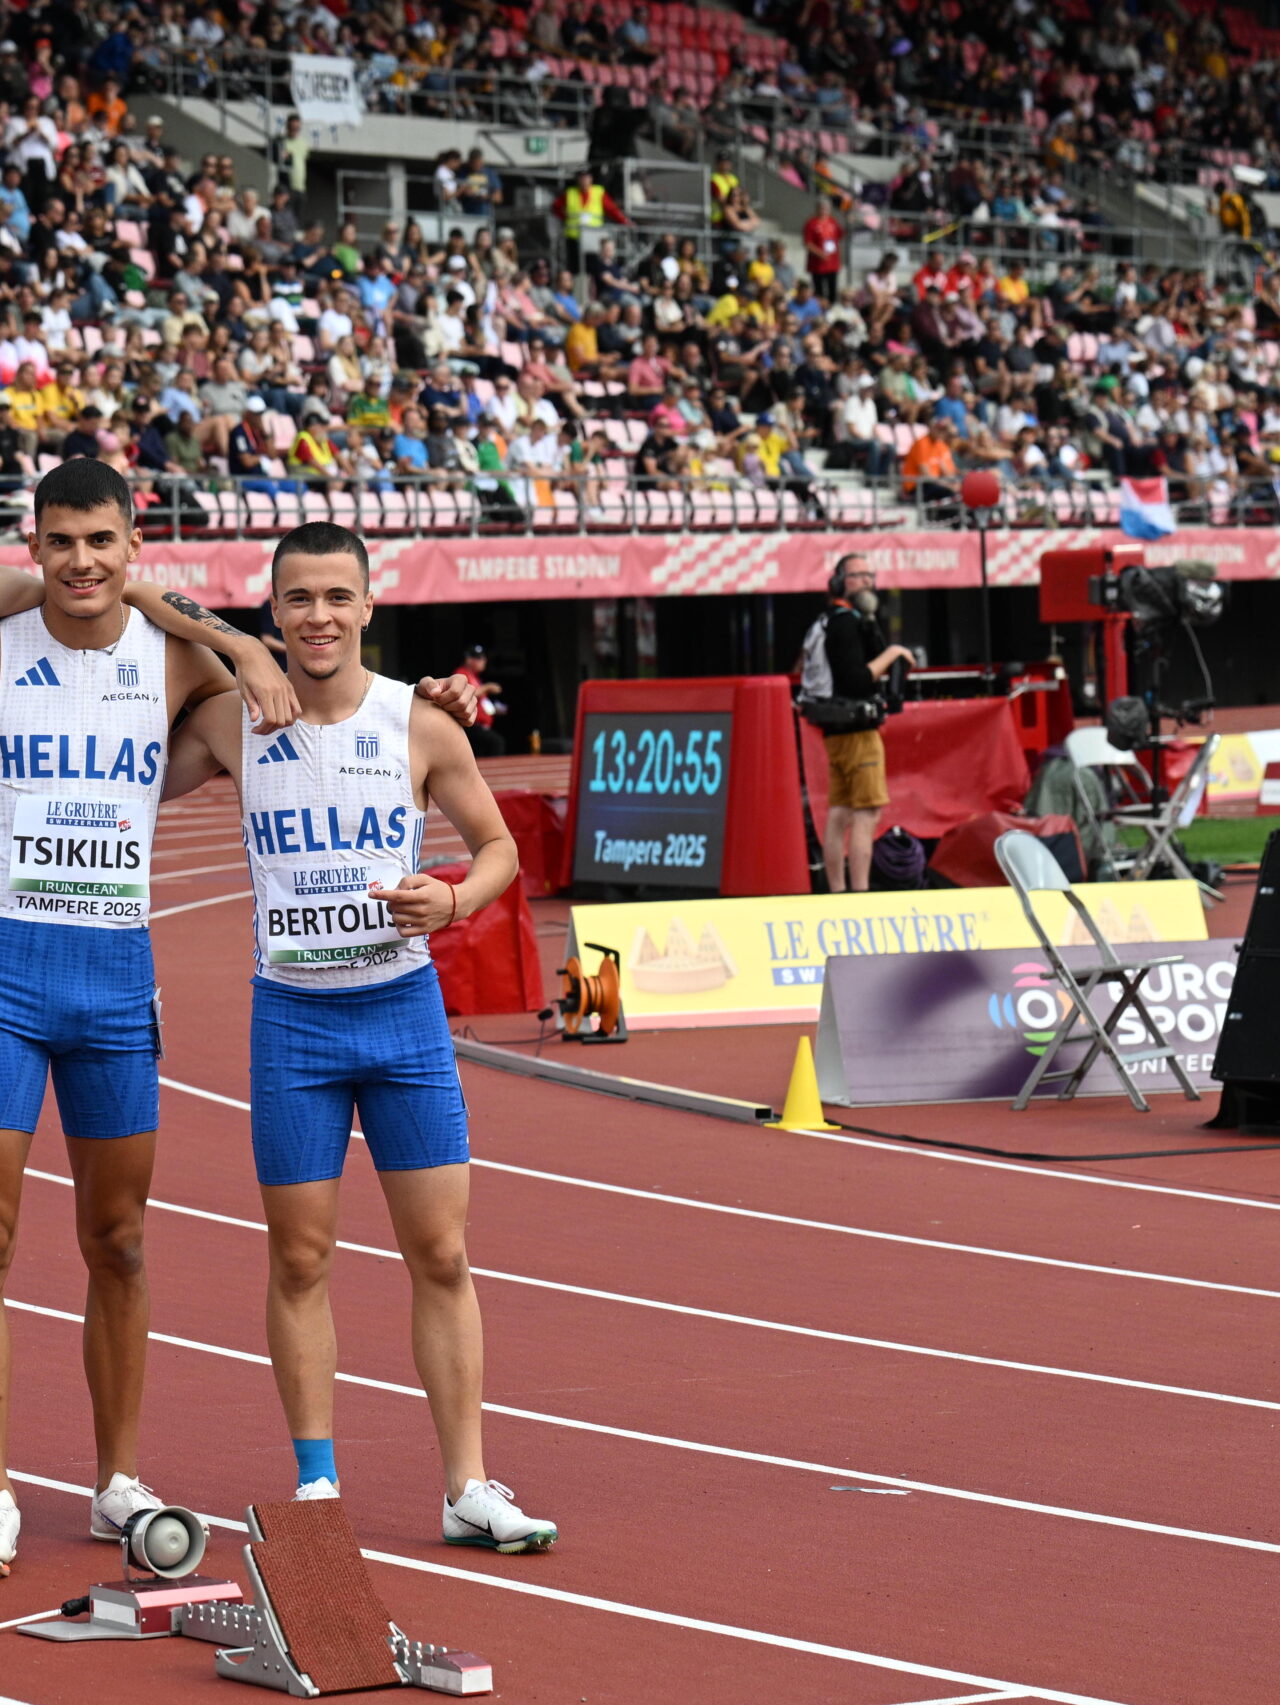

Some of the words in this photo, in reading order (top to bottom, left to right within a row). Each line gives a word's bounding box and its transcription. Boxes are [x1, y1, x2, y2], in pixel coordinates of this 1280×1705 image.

[456, 555, 540, 581] TAMPERE
[101, 692, 150, 702] AEGEAN
[0, 735, 161, 786] HELLAS
[589, 729, 723, 795] 13:20:55
[339, 767, 391, 777] AEGEAN
[47, 801, 62, 816] LE
[64, 800, 118, 819] GRUYÈRE
[49, 818, 115, 828] SWITZERLAND
[250, 806, 407, 855] HELLAS
[13, 835, 140, 870] TSIKILIS
[594, 830, 663, 872] Tampere
[663, 833, 708, 867] 2025
[293, 871, 307, 887] LE
[310, 865, 368, 886] GRUYÈRE
[46, 882, 75, 893] RUN
[298, 885, 364, 895] SWITZERLAND
[16, 896, 99, 915] TAMPERE
[103, 902, 141, 917] 2025
[764, 920, 810, 961] LE
[817, 907, 982, 957] GRUYÈRE
[304, 950, 332, 961] RUN
